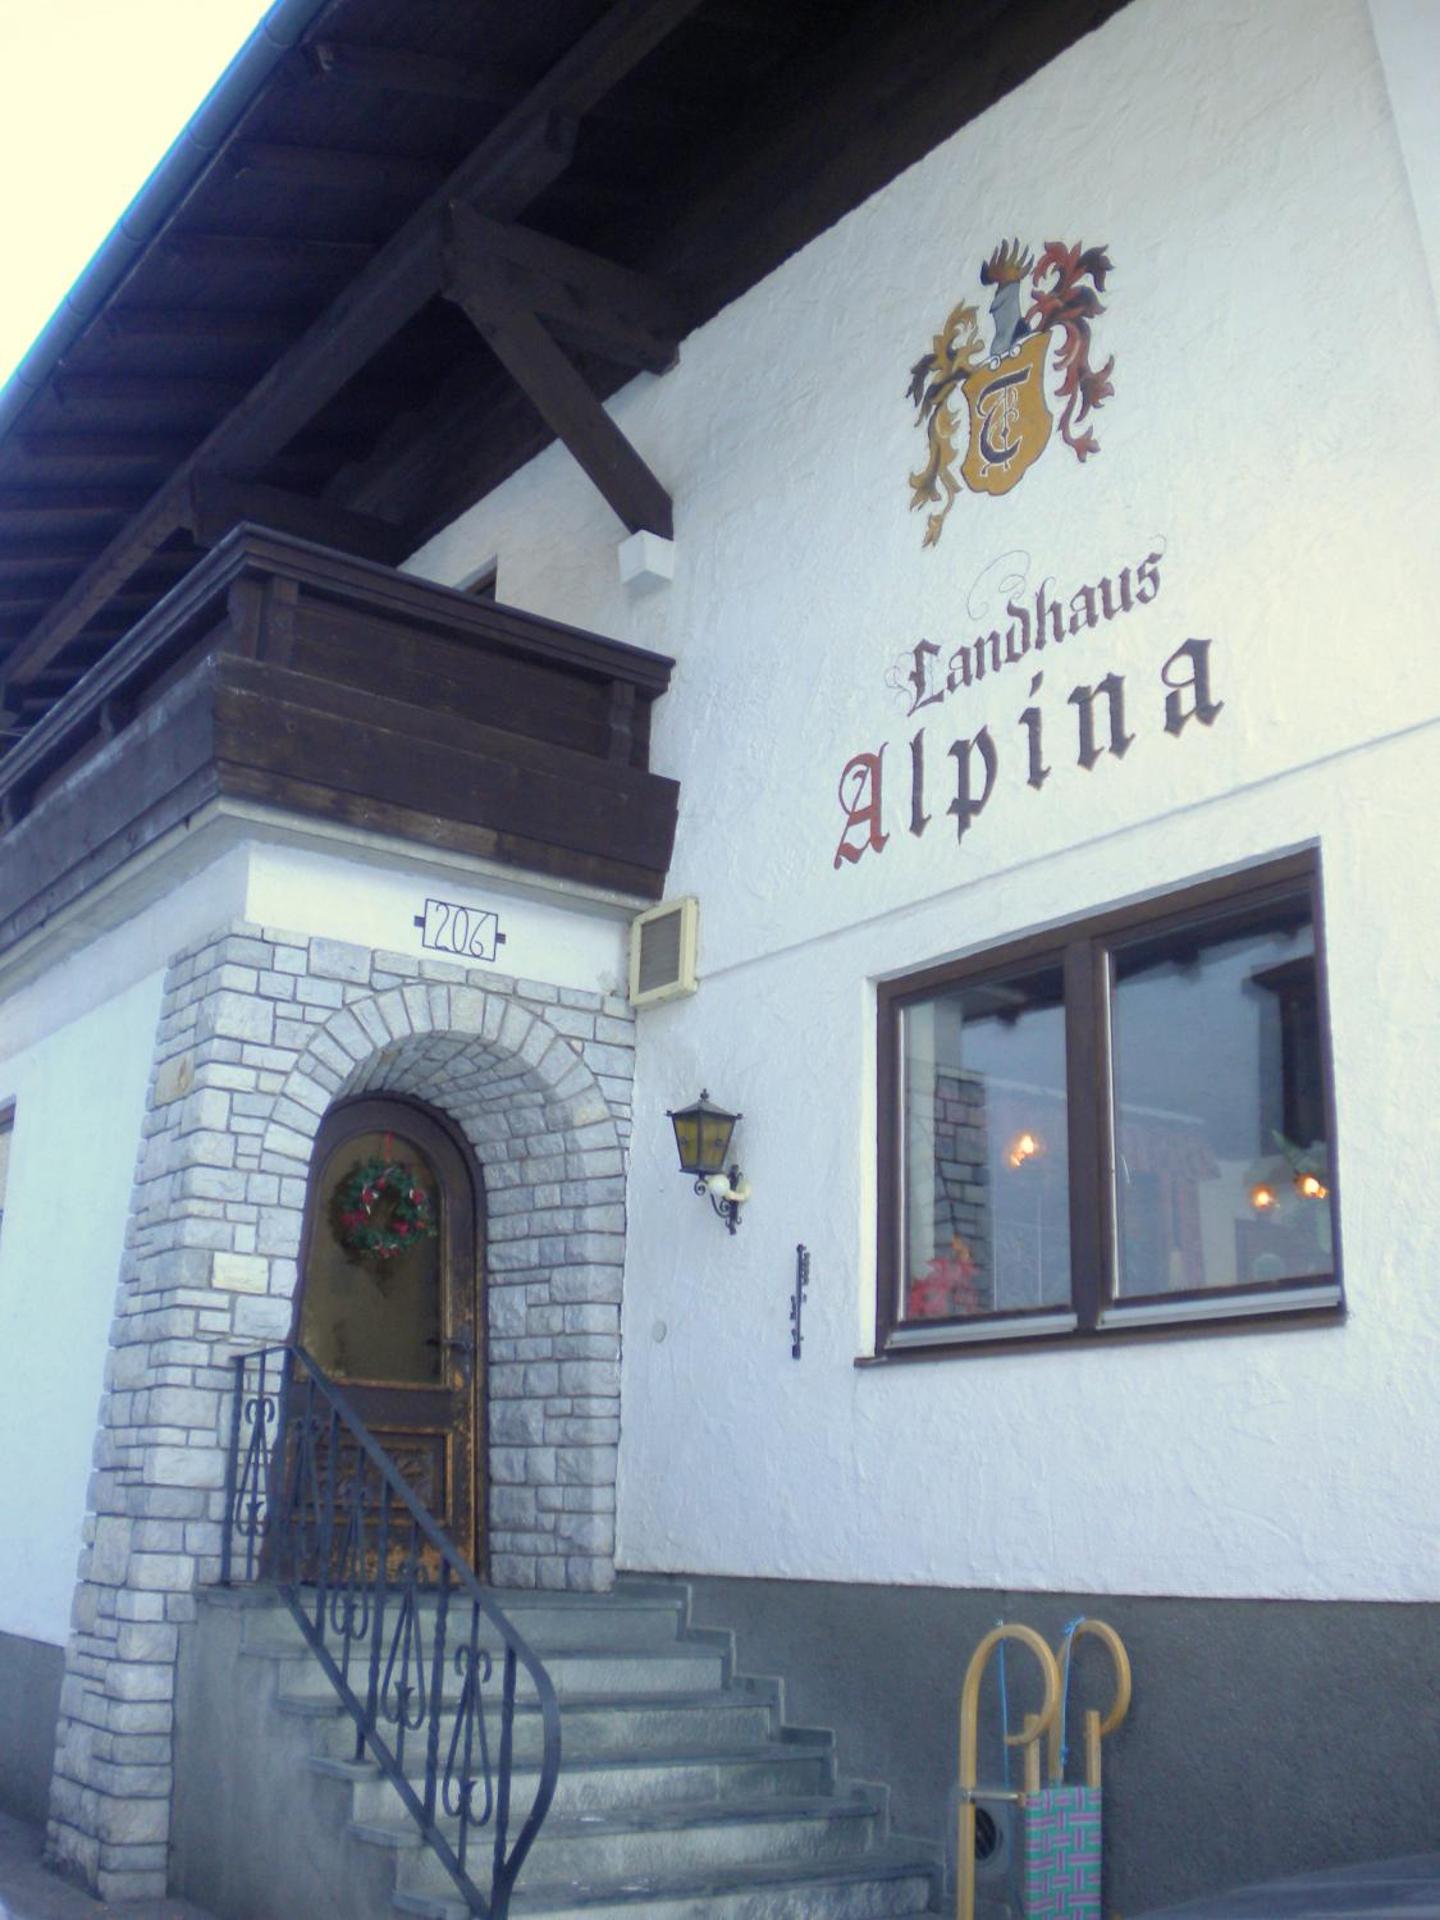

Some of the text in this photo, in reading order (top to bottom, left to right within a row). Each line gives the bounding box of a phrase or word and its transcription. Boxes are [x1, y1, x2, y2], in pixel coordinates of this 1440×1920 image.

[893, 546, 1164, 717] Landhaus
[833, 638, 1224, 869] Alpina
[434, 901, 489, 957] 206
